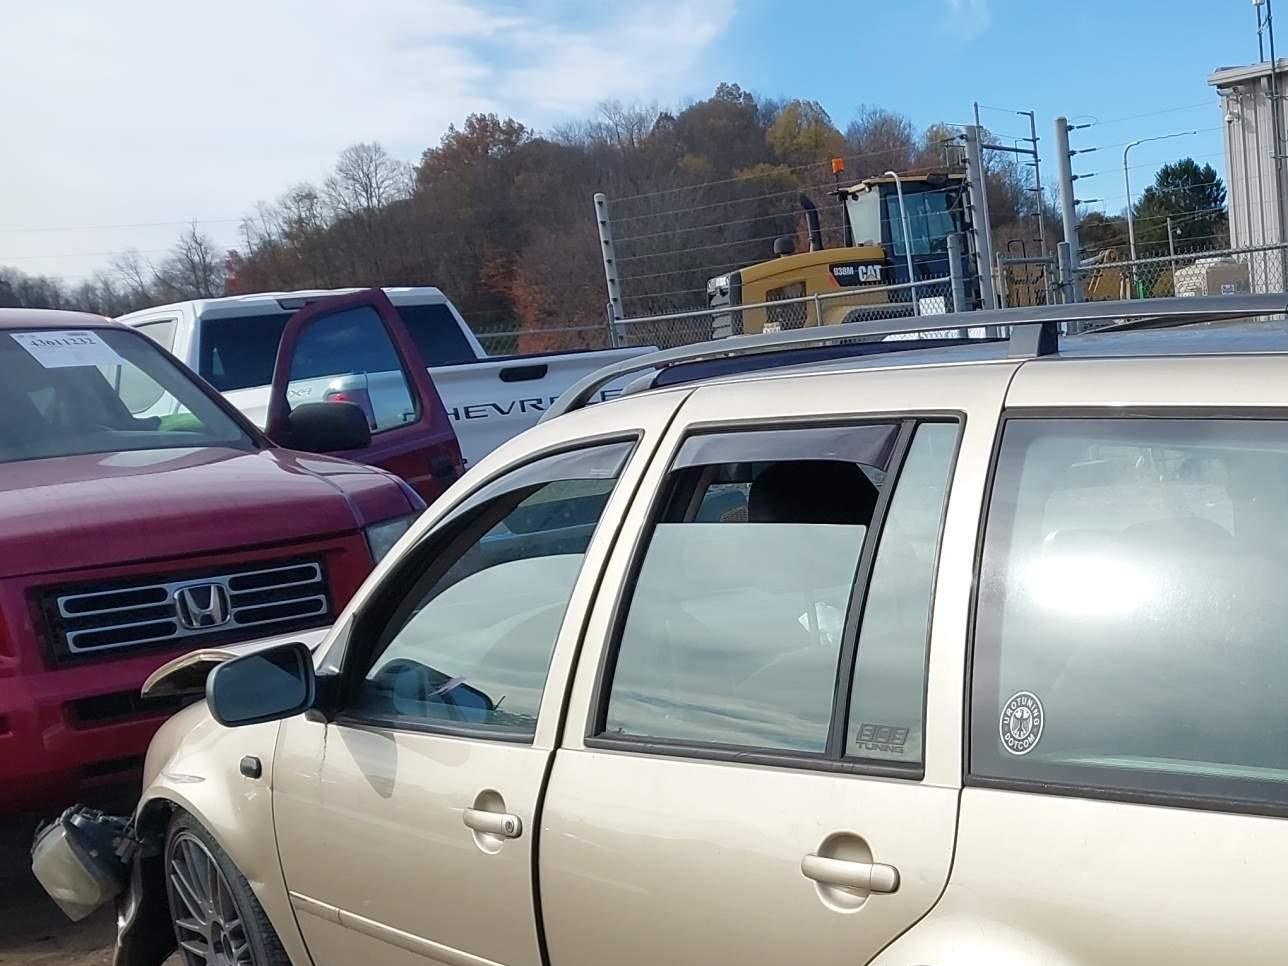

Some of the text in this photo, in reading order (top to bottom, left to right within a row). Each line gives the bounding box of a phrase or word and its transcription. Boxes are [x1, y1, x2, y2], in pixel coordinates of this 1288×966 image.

[858, 264, 882, 282] CAT
[1003, 696, 1040, 726] UROTUNING
[856, 741, 904, 754] TUNING
[1004, 731, 1036, 751] DOTCOM
